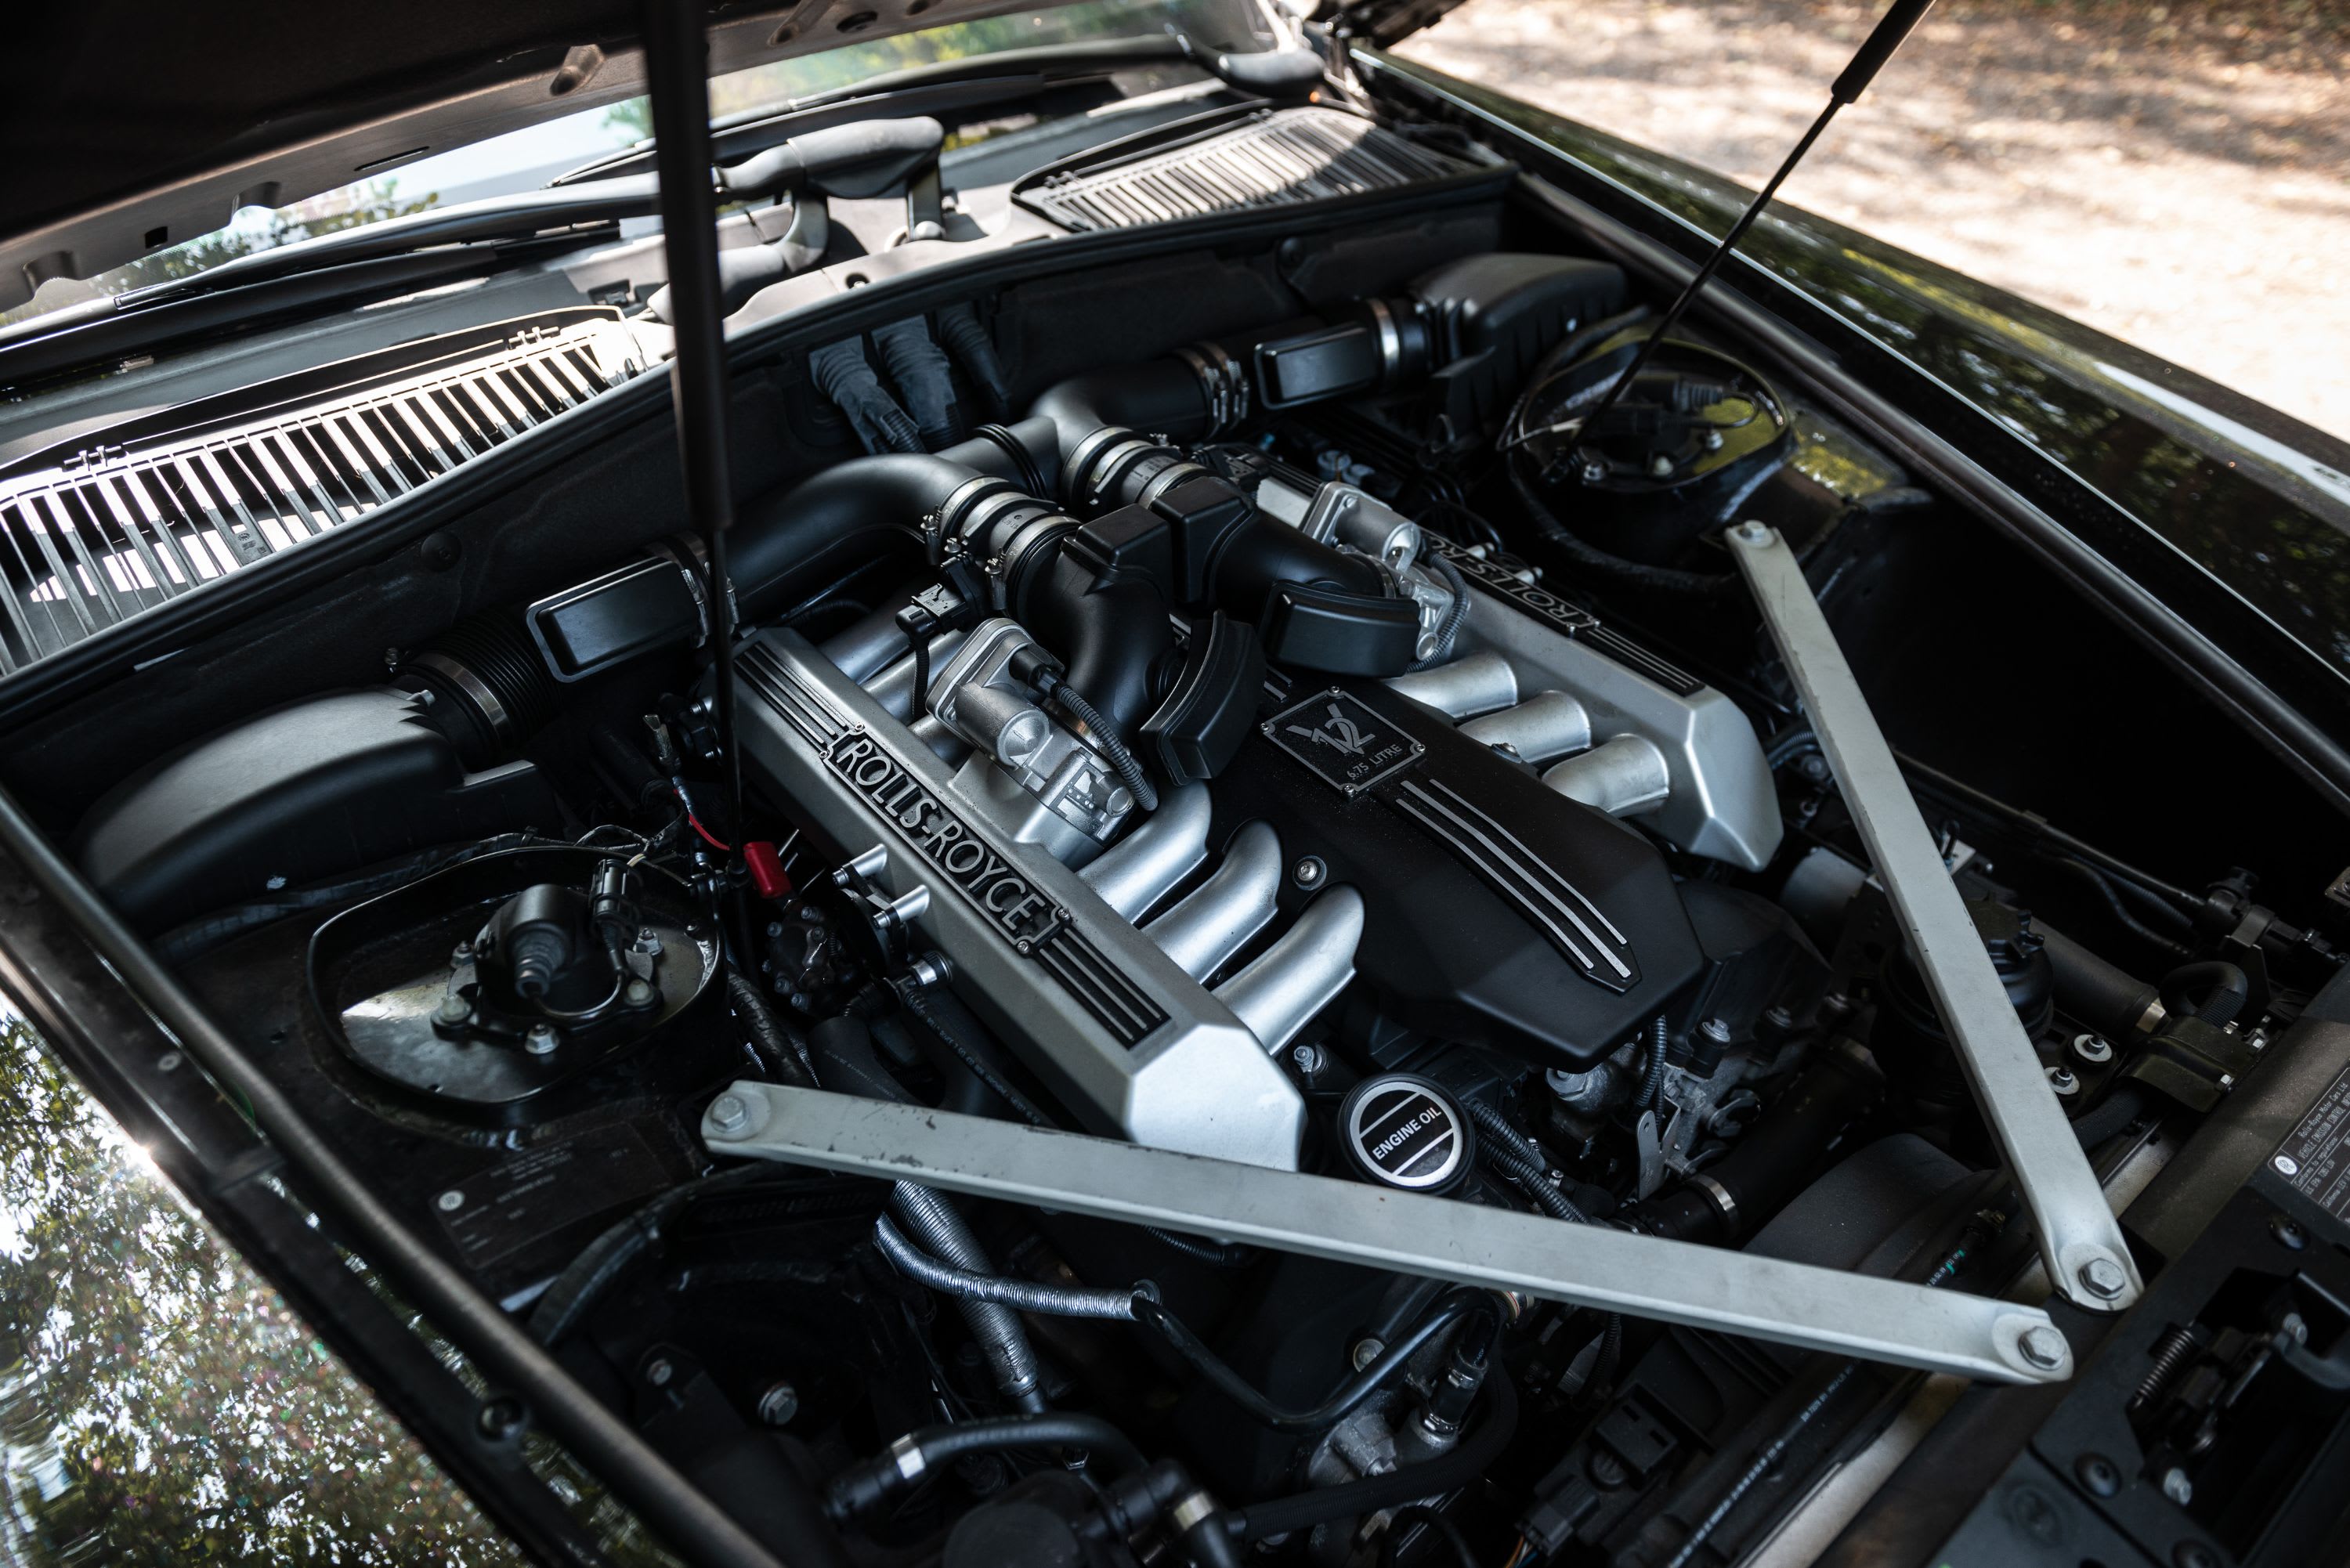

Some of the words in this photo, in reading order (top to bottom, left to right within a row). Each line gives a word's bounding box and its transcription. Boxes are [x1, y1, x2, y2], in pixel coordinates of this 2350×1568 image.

[1285, 703, 1376, 755] V12
[1347, 762, 1369, 779] 6.75
[1368, 743, 1403, 765] LITRE
[837, 739, 1046, 930] ROLLS-ROYCE
[1372, 1118, 1422, 1160] ENGINE
[1419, 1107, 1442, 1124] OIL
[2297, 1140, 2317, 1159] VEHICLE
[2312, 1121, 2332, 1143] EMISSION
[2326, 1105, 2346, 1125] CONTROL
[2298, 1113, 2323, 1138] Rolls-Royce
[2319, 1101, 2332, 1114] Motor
[2329, 1091, 2341, 1102] Cars
